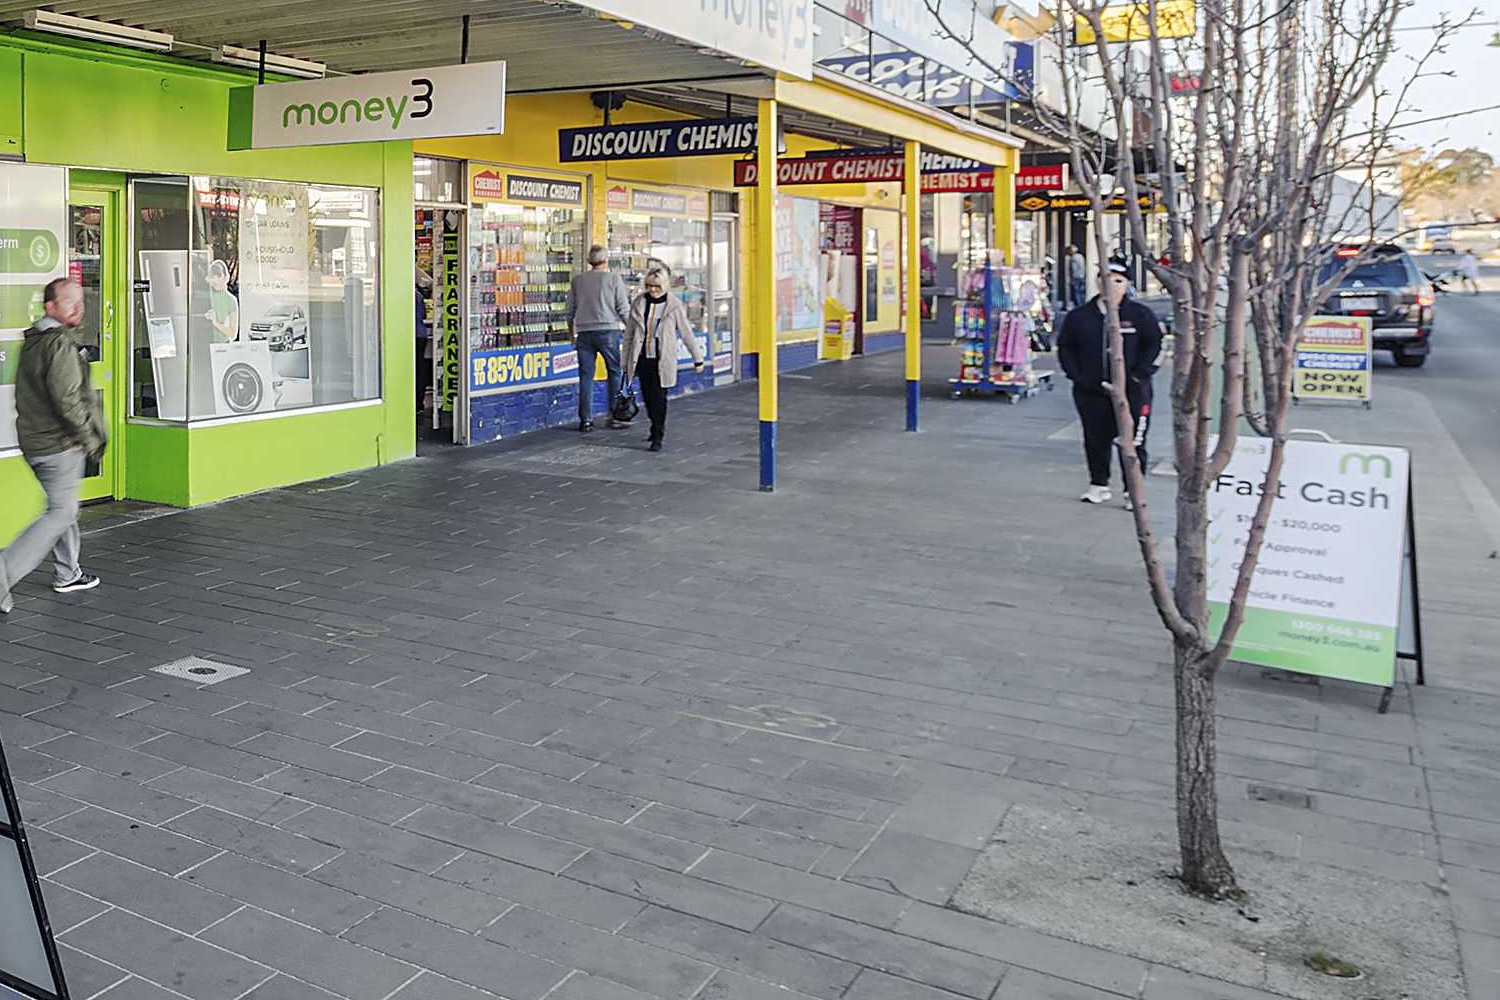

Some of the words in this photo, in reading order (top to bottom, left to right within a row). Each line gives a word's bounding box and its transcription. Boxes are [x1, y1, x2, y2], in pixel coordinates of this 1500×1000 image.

[283, 78, 434, 129] money3
[572, 127, 673, 157] DISCOUNT
[744, 162, 828, 182] DOUNT
[832, 158, 906, 180] CHEMIST
[474, 177, 502, 191] CHEMIST
[509, 178, 548, 198] DISCOUNT
[550, 182, 581, 200] CHEMIST
[920, 172, 979, 190] HEMIST
[473, 357, 487, 373] UP
[1298, 352, 1366, 362] DISCOUNT
[1303, 360, 1360, 369] CHEMIST
[487, 355, 522, 386] 85%
[523, 351, 550, 380] OFF
[1304, 372, 1359, 382] NOW
[474, 371, 486, 386] TO
[1303, 382, 1362, 394] OPEN
[1301, 481, 1389, 510] Cash
[1282, 517, 1341, 534] $20,000
[1266, 541, 1328, 557] Approval
[1293, 565, 1345, 585] Cashed
[1281, 592, 1336, 609] Finance
